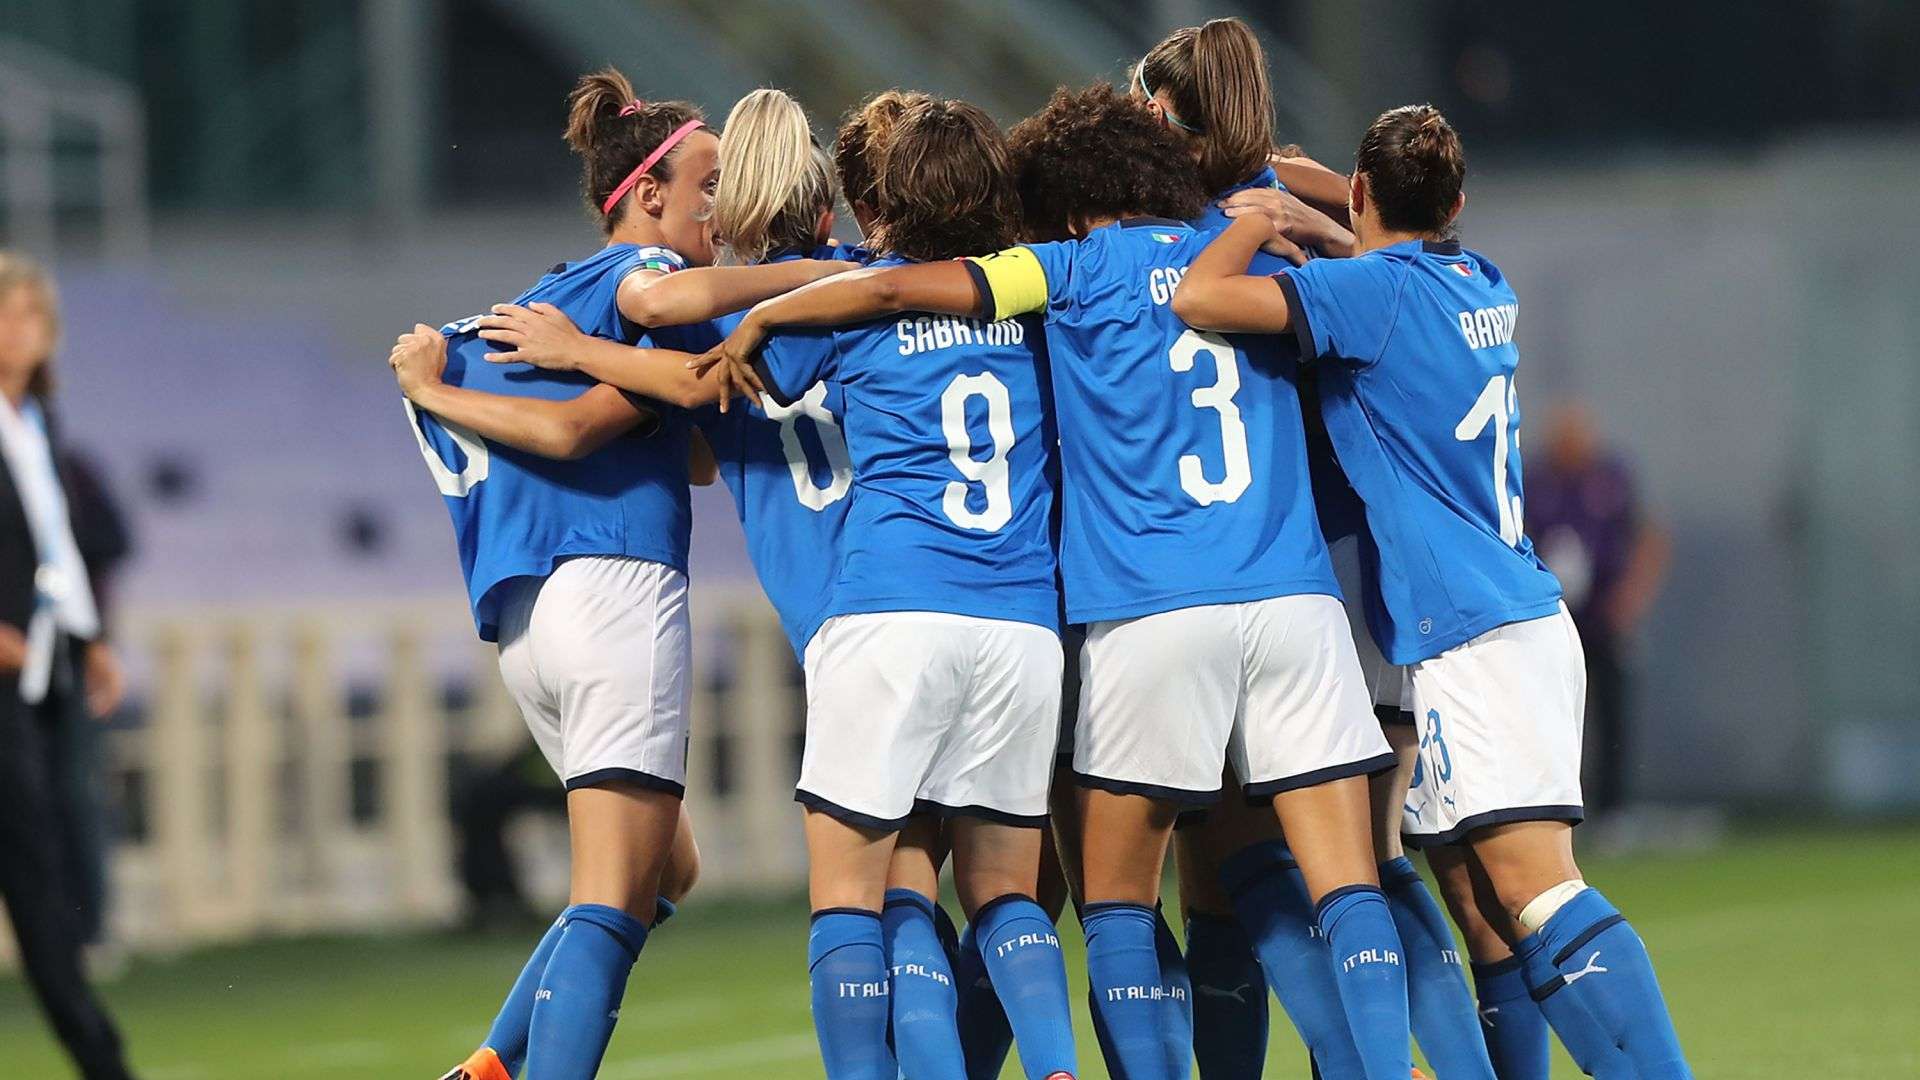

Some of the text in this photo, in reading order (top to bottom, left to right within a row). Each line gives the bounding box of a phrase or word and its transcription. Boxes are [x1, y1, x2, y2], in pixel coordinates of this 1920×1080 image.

[1169, 329, 1252, 507] 3
[941, 371, 1015, 533] 9
[997, 932, 1060, 958] ITALIA
[1343, 948, 1400, 973] ITALIA
[1107, 985, 1161, 1002] ITALIA
